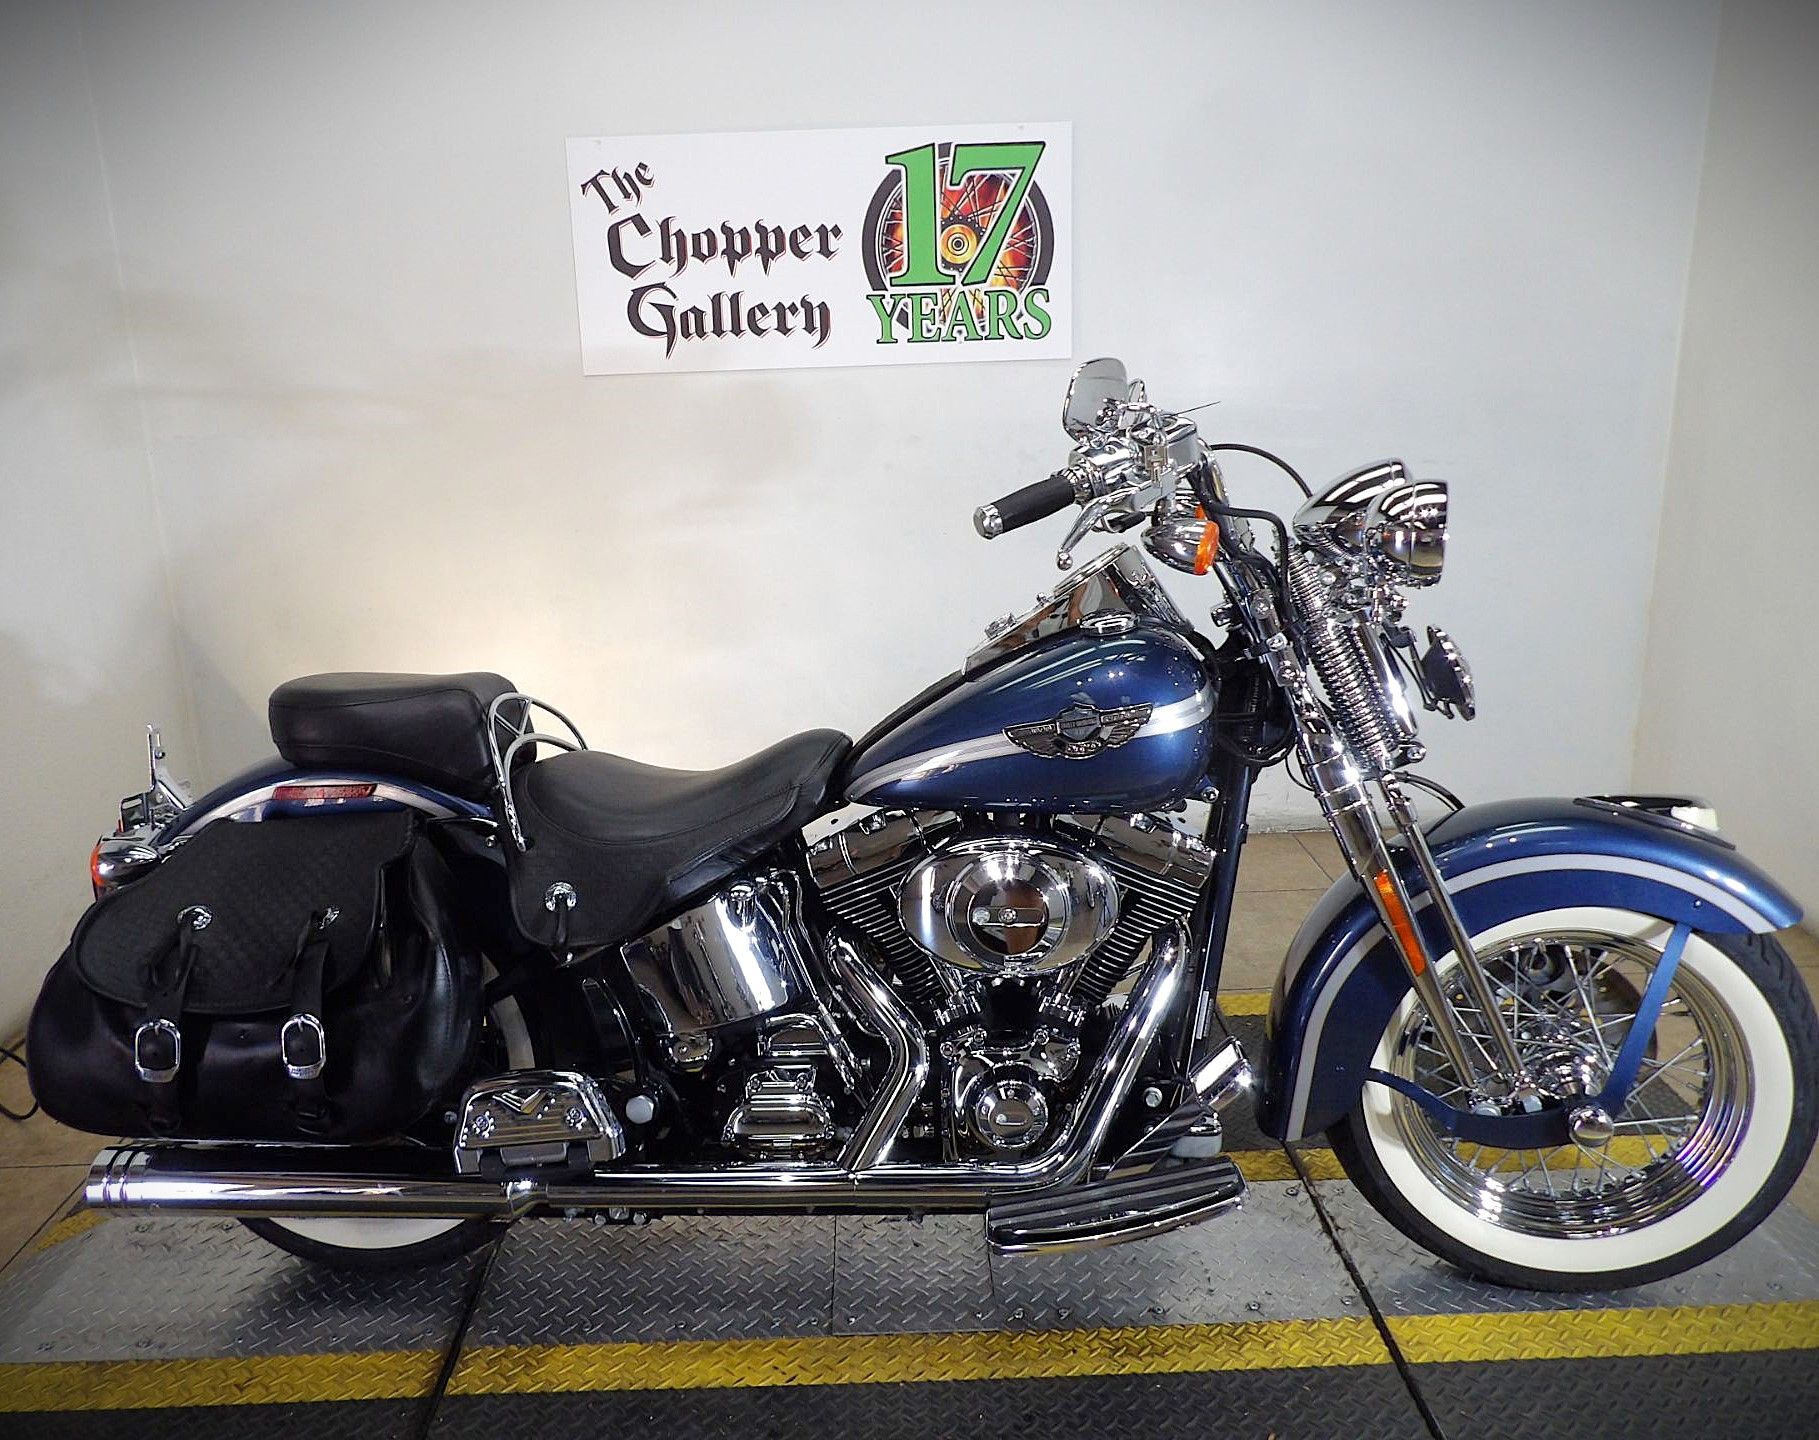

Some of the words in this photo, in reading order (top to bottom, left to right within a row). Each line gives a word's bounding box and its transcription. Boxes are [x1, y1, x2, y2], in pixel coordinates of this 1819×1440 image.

[581, 161, 656, 215] The
[885, 141, 1047, 287] 17
[606, 213, 843, 280] Chopper
[626, 281, 832, 360] Gallery
[866, 288, 1053, 345] YEARS
